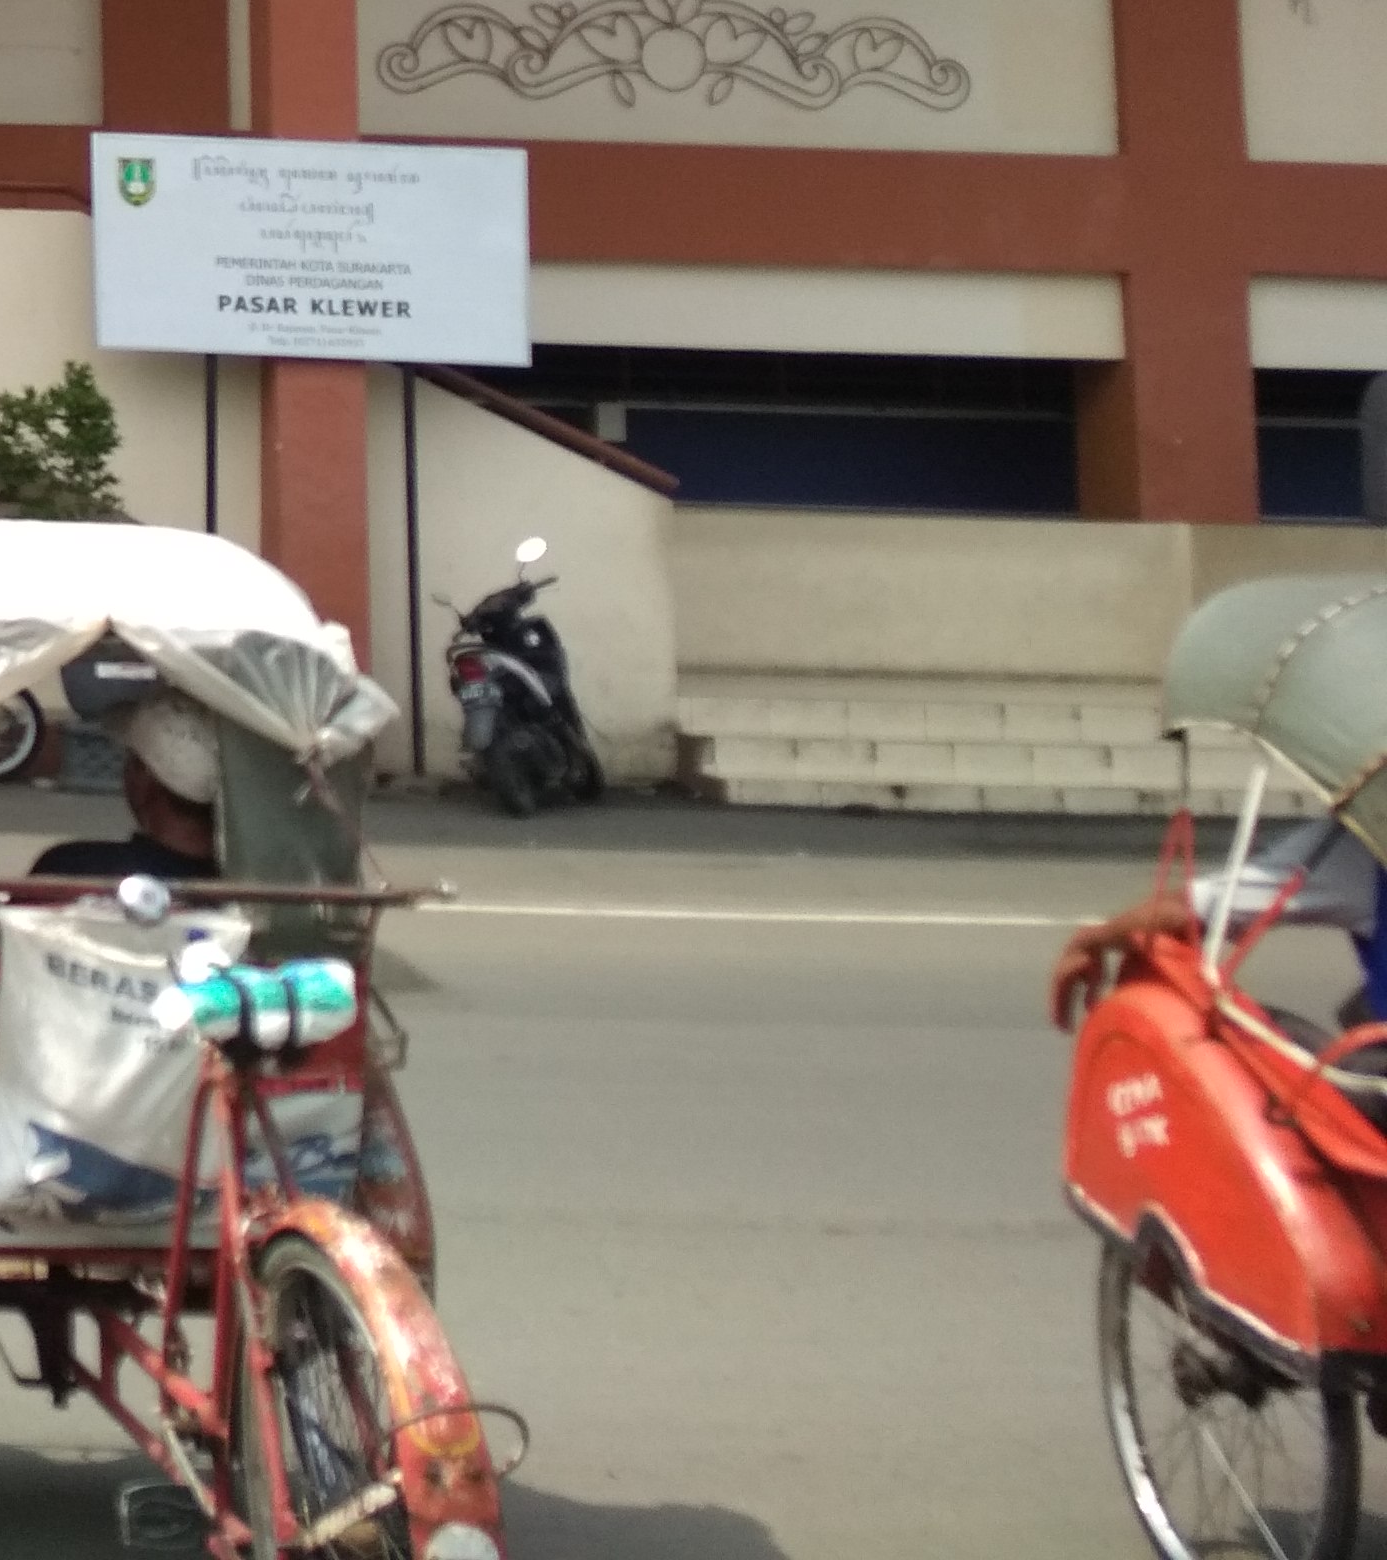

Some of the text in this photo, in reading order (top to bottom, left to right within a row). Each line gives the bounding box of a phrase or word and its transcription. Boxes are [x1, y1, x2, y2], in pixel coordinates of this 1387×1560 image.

[215, 256, 413, 276] PEMERINTAH KOTA SURAKARTA
[245, 274, 385, 291] DINAS PERDAGANGAN
[217, 294, 413, 320] PASAR KLEWER
